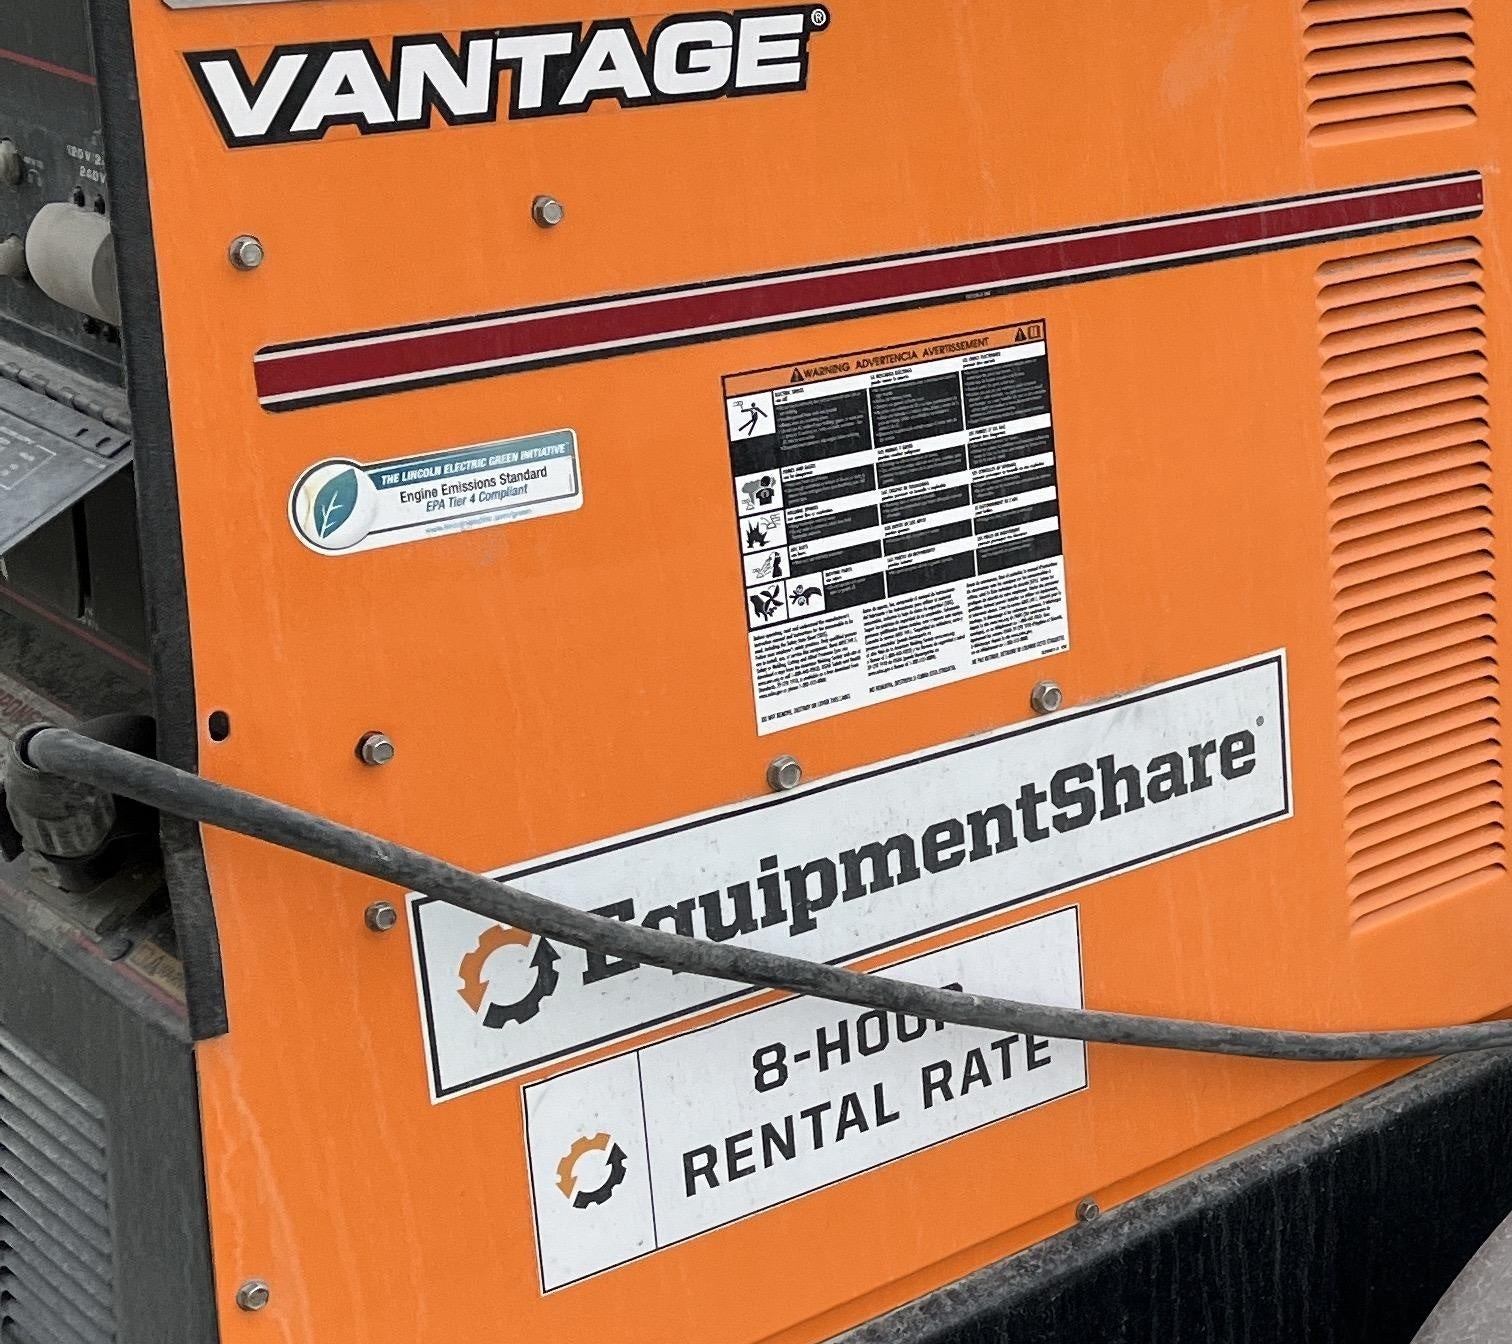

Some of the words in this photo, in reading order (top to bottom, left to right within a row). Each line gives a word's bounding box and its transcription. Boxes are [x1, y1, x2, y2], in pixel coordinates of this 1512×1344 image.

[801, 362, 850, 379] WARNING
[855, 350, 919, 370] ADVERTENCIA
[922, 337, 989, 358] AVERTISSEMENT
[381, 472, 400, 485] THE
[401, 465, 442, 482] LINCOLN
[443, 458, 488, 475] ELECTRIC
[488, 452, 519, 465] GREEN
[400, 486, 438, 504] Engine
[441, 475, 497, 495] Emissions
[499, 466, 548, 485] Standard
[426, 497, 446, 512] EPA
[448, 493, 466, 508] Tier
[469, 492, 476, 504] 4
[478, 483, 529, 503] Compliant
[682, 1082, 900, 1198] RENTAL
[921, 1033, 1052, 1109] RATE
